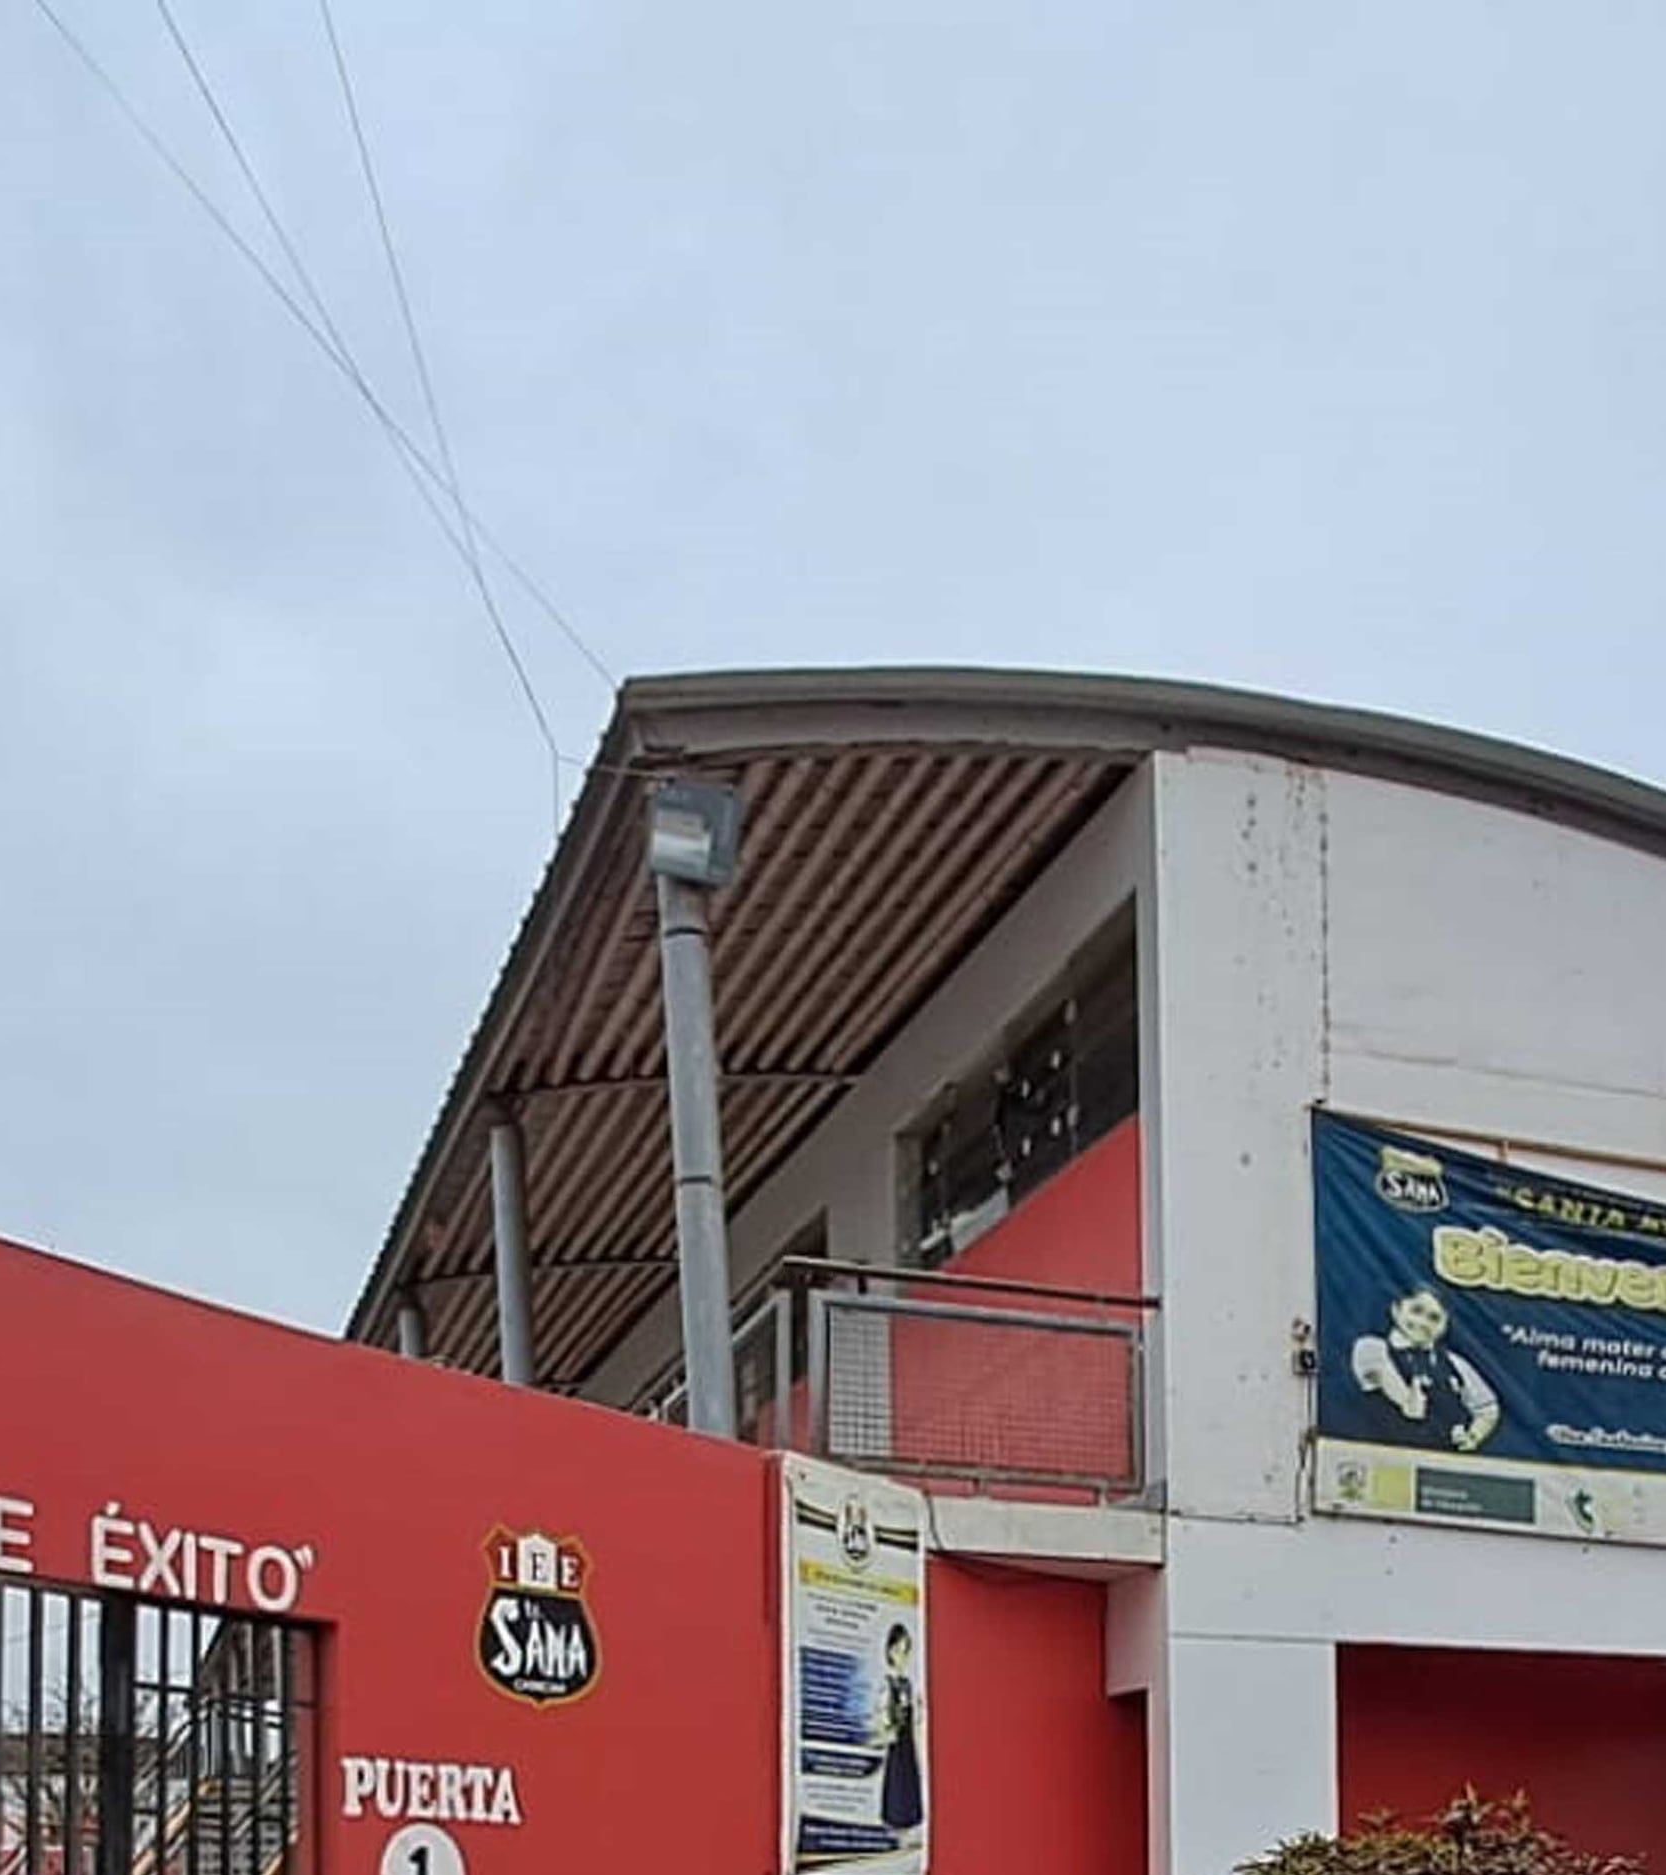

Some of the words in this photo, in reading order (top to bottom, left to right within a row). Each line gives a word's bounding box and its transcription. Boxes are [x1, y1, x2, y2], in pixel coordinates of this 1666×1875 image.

[1582, 1335, 1654, 1360] mater
[1536, 1350, 1654, 1379] femenina
[341, 1757, 522, 1824] PUERTA
